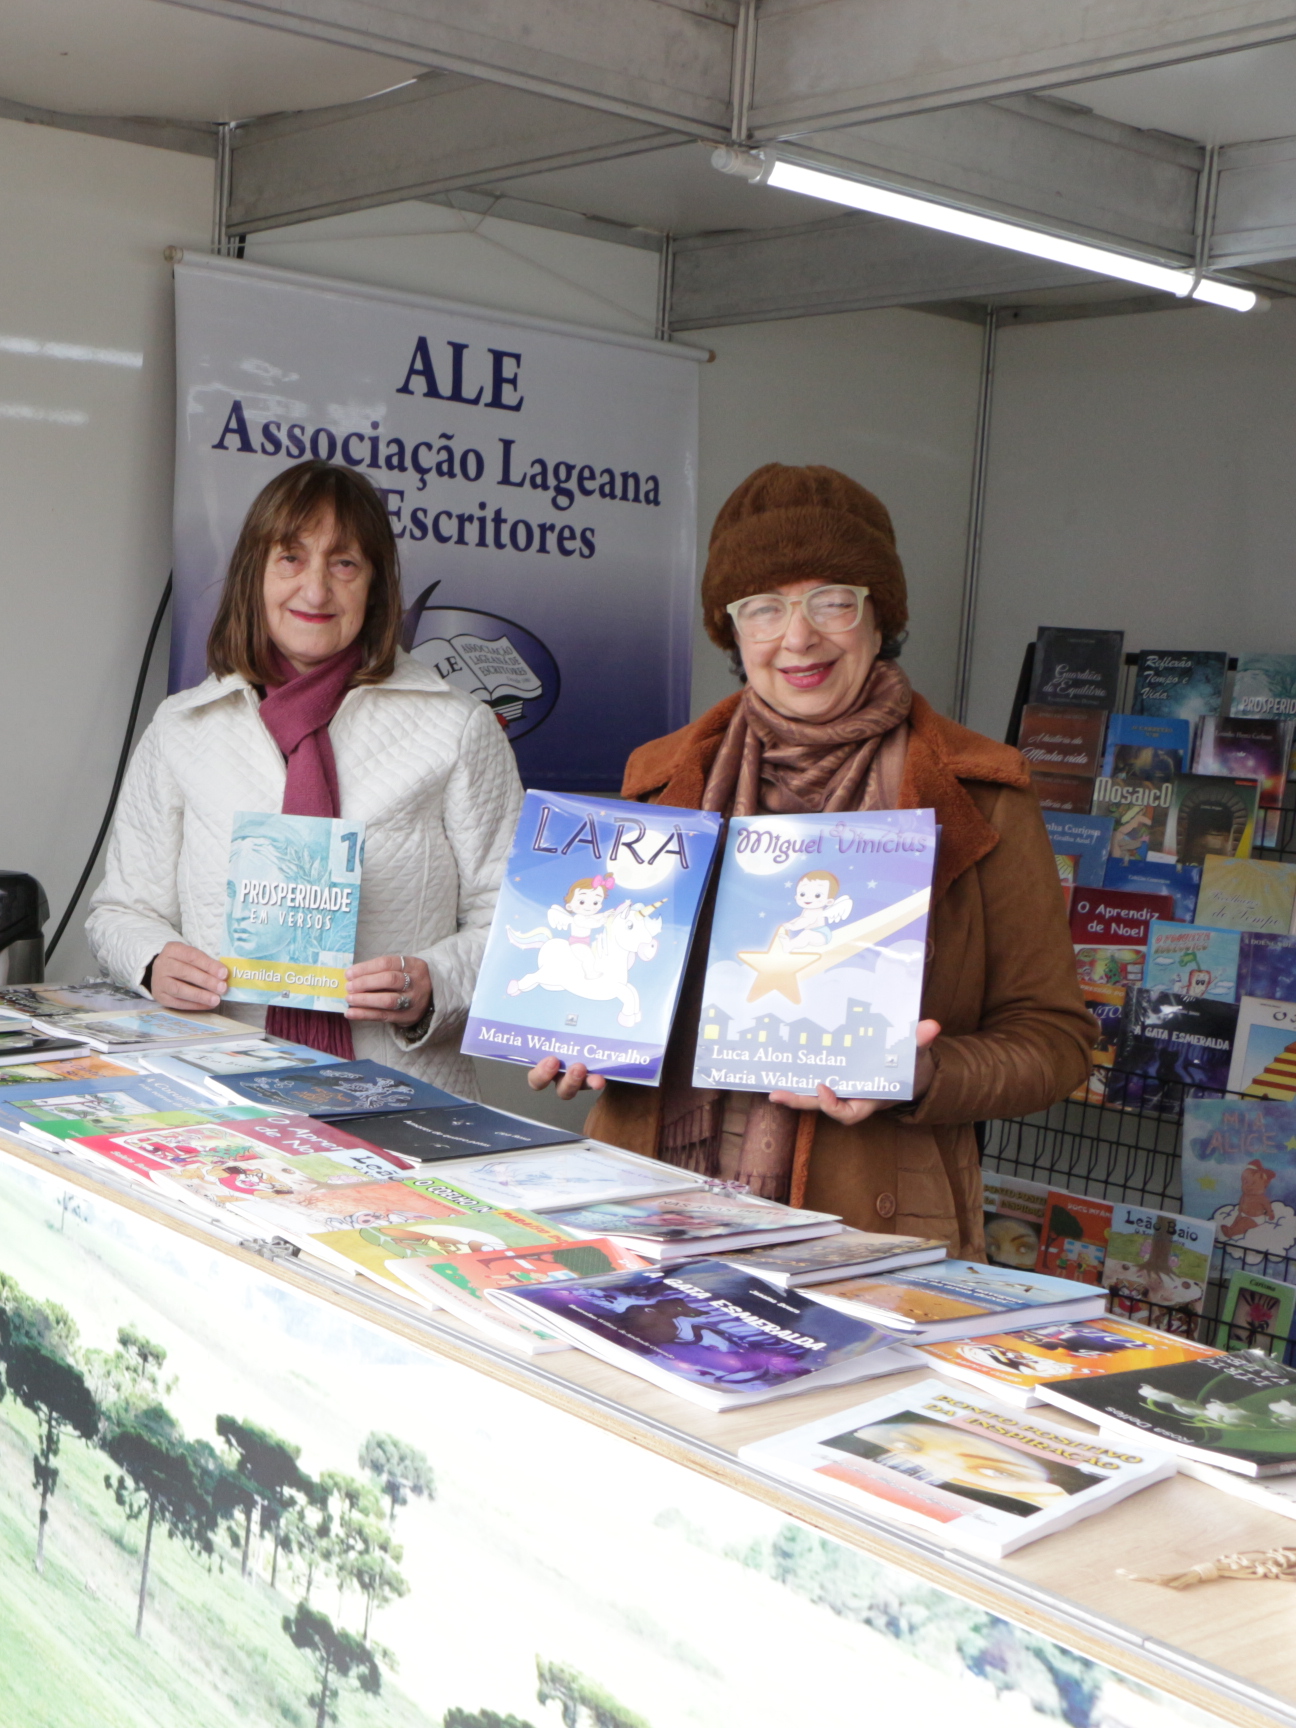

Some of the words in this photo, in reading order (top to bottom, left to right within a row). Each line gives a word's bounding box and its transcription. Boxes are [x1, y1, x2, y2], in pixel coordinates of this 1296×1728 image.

[395, 335, 525, 413] ALE
[211, 399, 485, 492] Associação
[497, 438, 662, 511] Lageana
[375, 487, 596, 559] Escritores
[433, 656, 463, 680] LE
[469, 654, 511, 666] LAGEANA
[511, 656, 522, 666] DE
[479, 664, 528, 677] ESCRITORES
[1144, 670, 1179, 685] Tempo
[531, 806, 689, 870] LARA
[735, 826, 823, 864] Miguel
[829, 820, 927, 855] Vinícius
[241, 879, 352, 912] PROSPERIDADE
[250, 909, 269, 924] EM
[279, 911, 332, 930] VERSOS
[1077, 901, 1090, 913] O
[1095, 903, 1160, 920] Aprendiz
[1087, 920, 1104, 933] de
[1110, 922, 1144, 938] Noel
[232, 966, 281, 983] Ivanilda
[284, 971, 339, 988] Godinho
[478, 1026, 523, 1047] Maria
[526, 1032, 580, 1056] Waltair
[582, 1042, 651, 1066] Carvalho
[1134, 1026, 1141, 1035] A
[1145, 1027, 1169, 1039] GATA
[1172, 1031, 1230, 1050] ESMERALDA
[712, 1045, 752, 1061] Luca
[755, 1047, 793, 1063] Alon
[797, 1049, 847, 1066] Sadan
[710, 1068, 754, 1086] Maria
[756, 1070, 822, 1089] Waltair
[825, 1074, 901, 1093] Carvalho
[254, 1126, 281, 1137] de
[1223, 1112, 1266, 1130] MIA
[1206, 1131, 1278, 1154] ALICE
[426, 1185, 479, 1207] COELHO
[658, 1200, 692, 1208] NAS
[1125, 1210, 1162, 1231] Leão
[1166, 1221, 1199, 1241] Baio
[663, 1278, 712, 1299] GATA
[709, 1299, 827, 1351] ESMERALDA
[923, 1403, 956, 1417] DA
[964, 1417, 1120, 1470] INSPIRAÇÃO
[934, 1394, 1018, 1426] PONTO
[1019, 1425, 1143, 1464] POSITIVO
